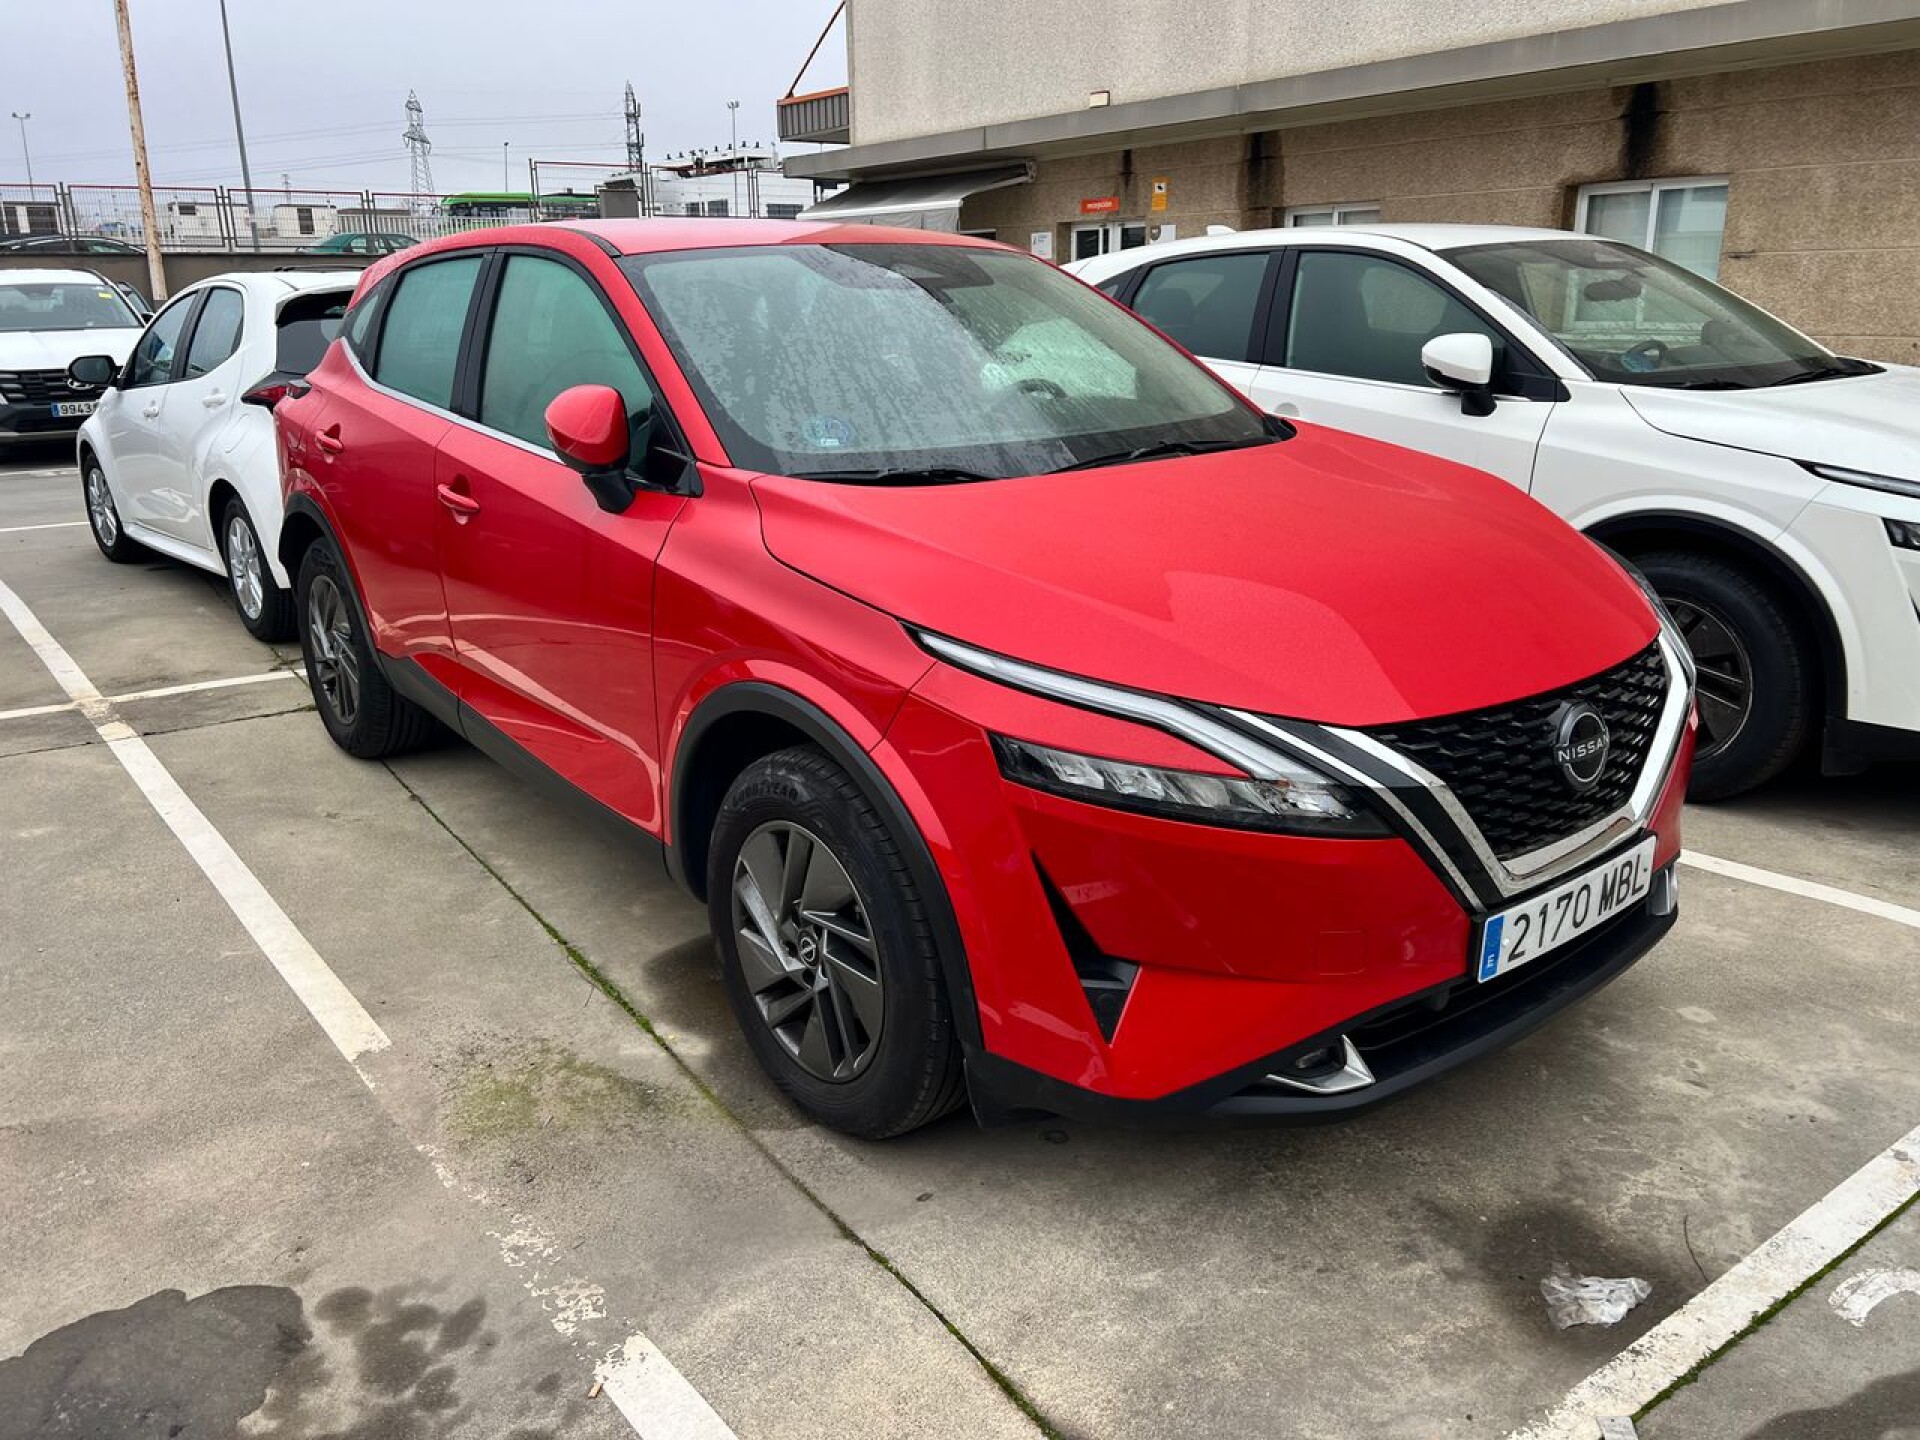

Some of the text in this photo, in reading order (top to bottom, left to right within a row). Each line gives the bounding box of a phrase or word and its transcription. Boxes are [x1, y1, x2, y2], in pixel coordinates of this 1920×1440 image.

[61, 403, 92, 414] 9943
[1507, 854, 1645, 964] 2170 MBL
